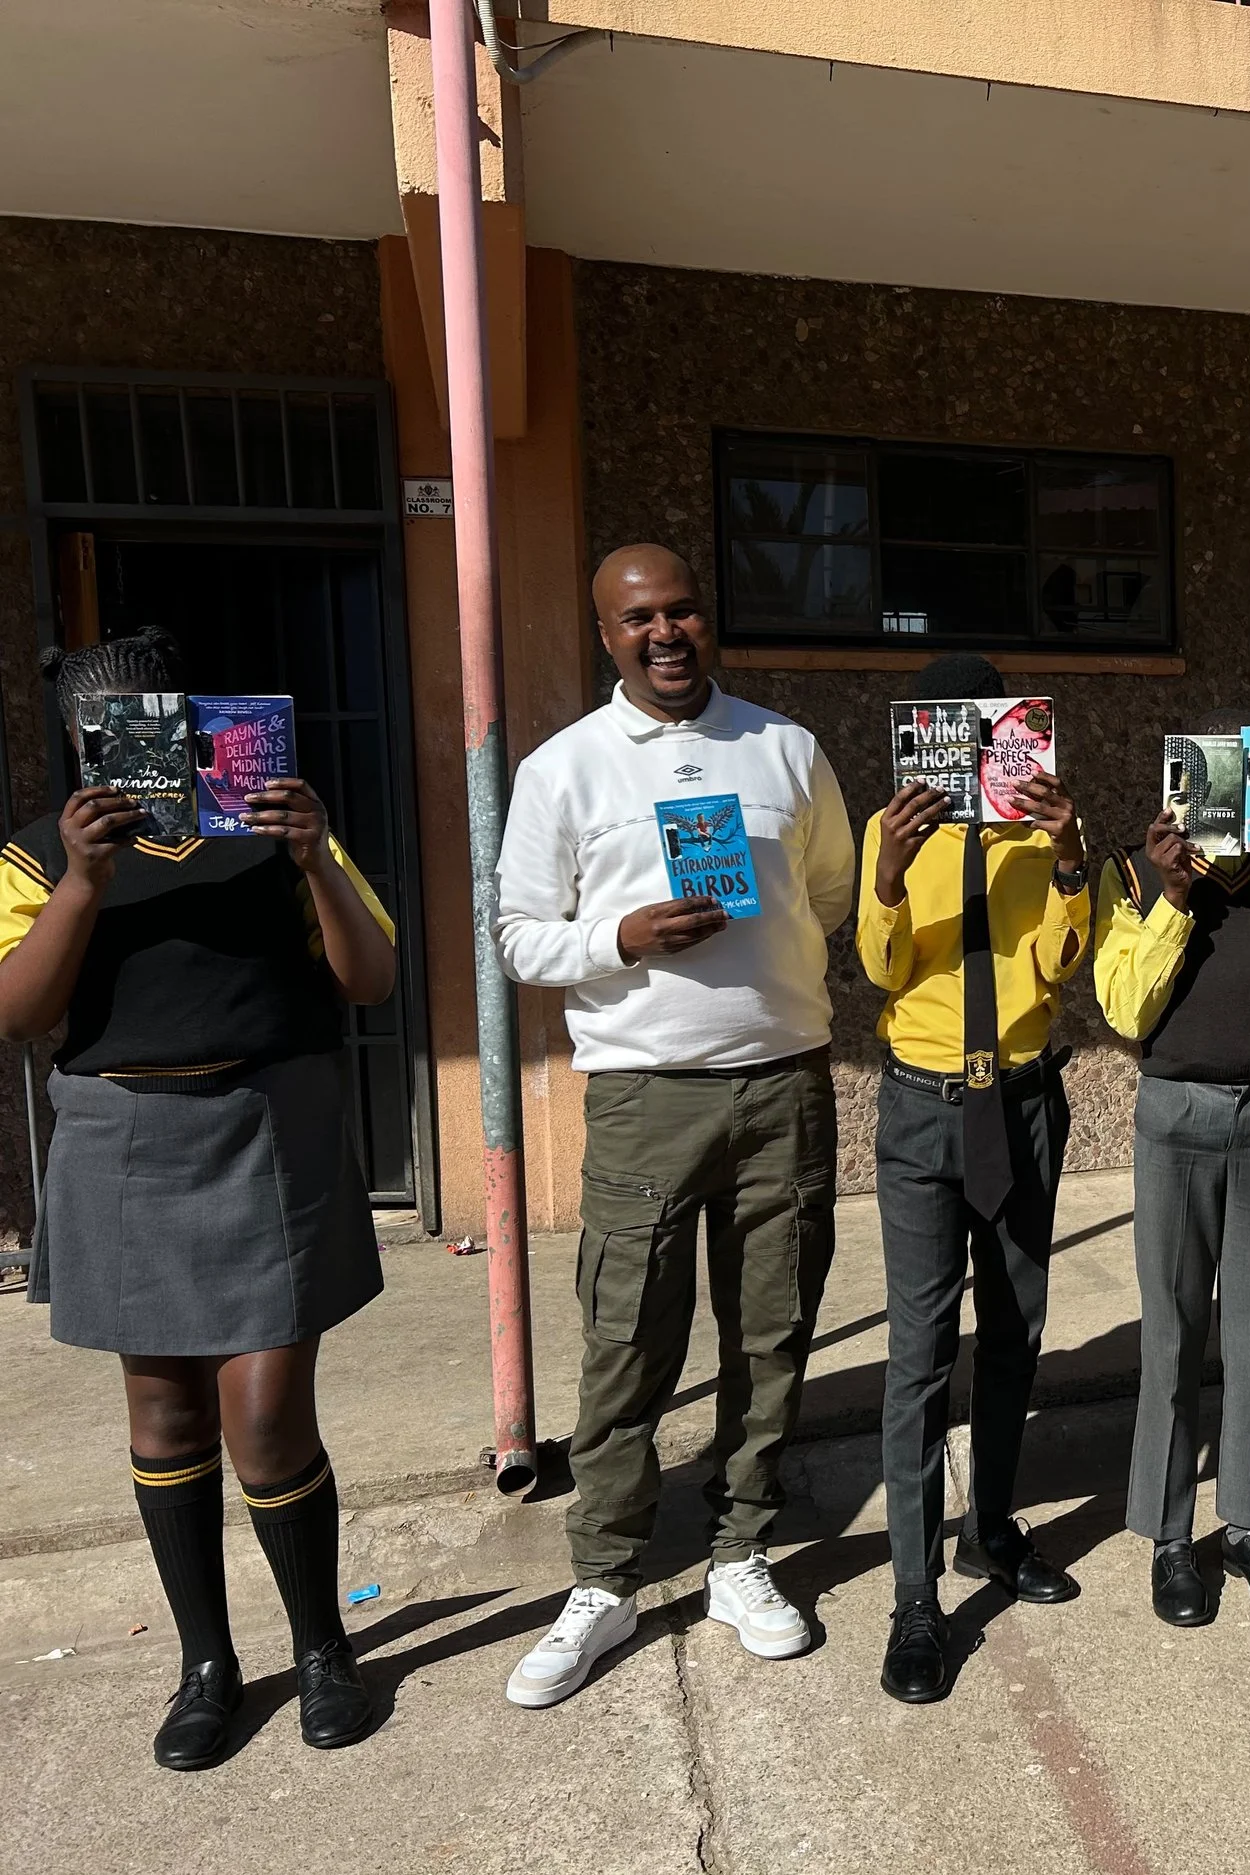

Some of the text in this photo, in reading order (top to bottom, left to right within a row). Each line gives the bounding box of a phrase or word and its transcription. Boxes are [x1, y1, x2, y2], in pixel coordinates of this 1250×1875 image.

[407, 503, 451, 514] NO. 7
[224, 714, 286, 745] RAYNE &
[912, 720, 971, 745] IVING
[1010, 728, 1015, 739] A
[992, 737, 1039, 751] THOUSAND
[921, 746, 973, 769] HOPE
[985, 750, 1031, 766] PERFECT
[1002, 763, 1033, 777] NOTES
[677, 776, 703, 784] umbro
[1202, 811, 1236, 819] PSYNODE
[208, 815, 238, 832] Jeff
[671, 851, 747, 877] EXTRAORDINARY
